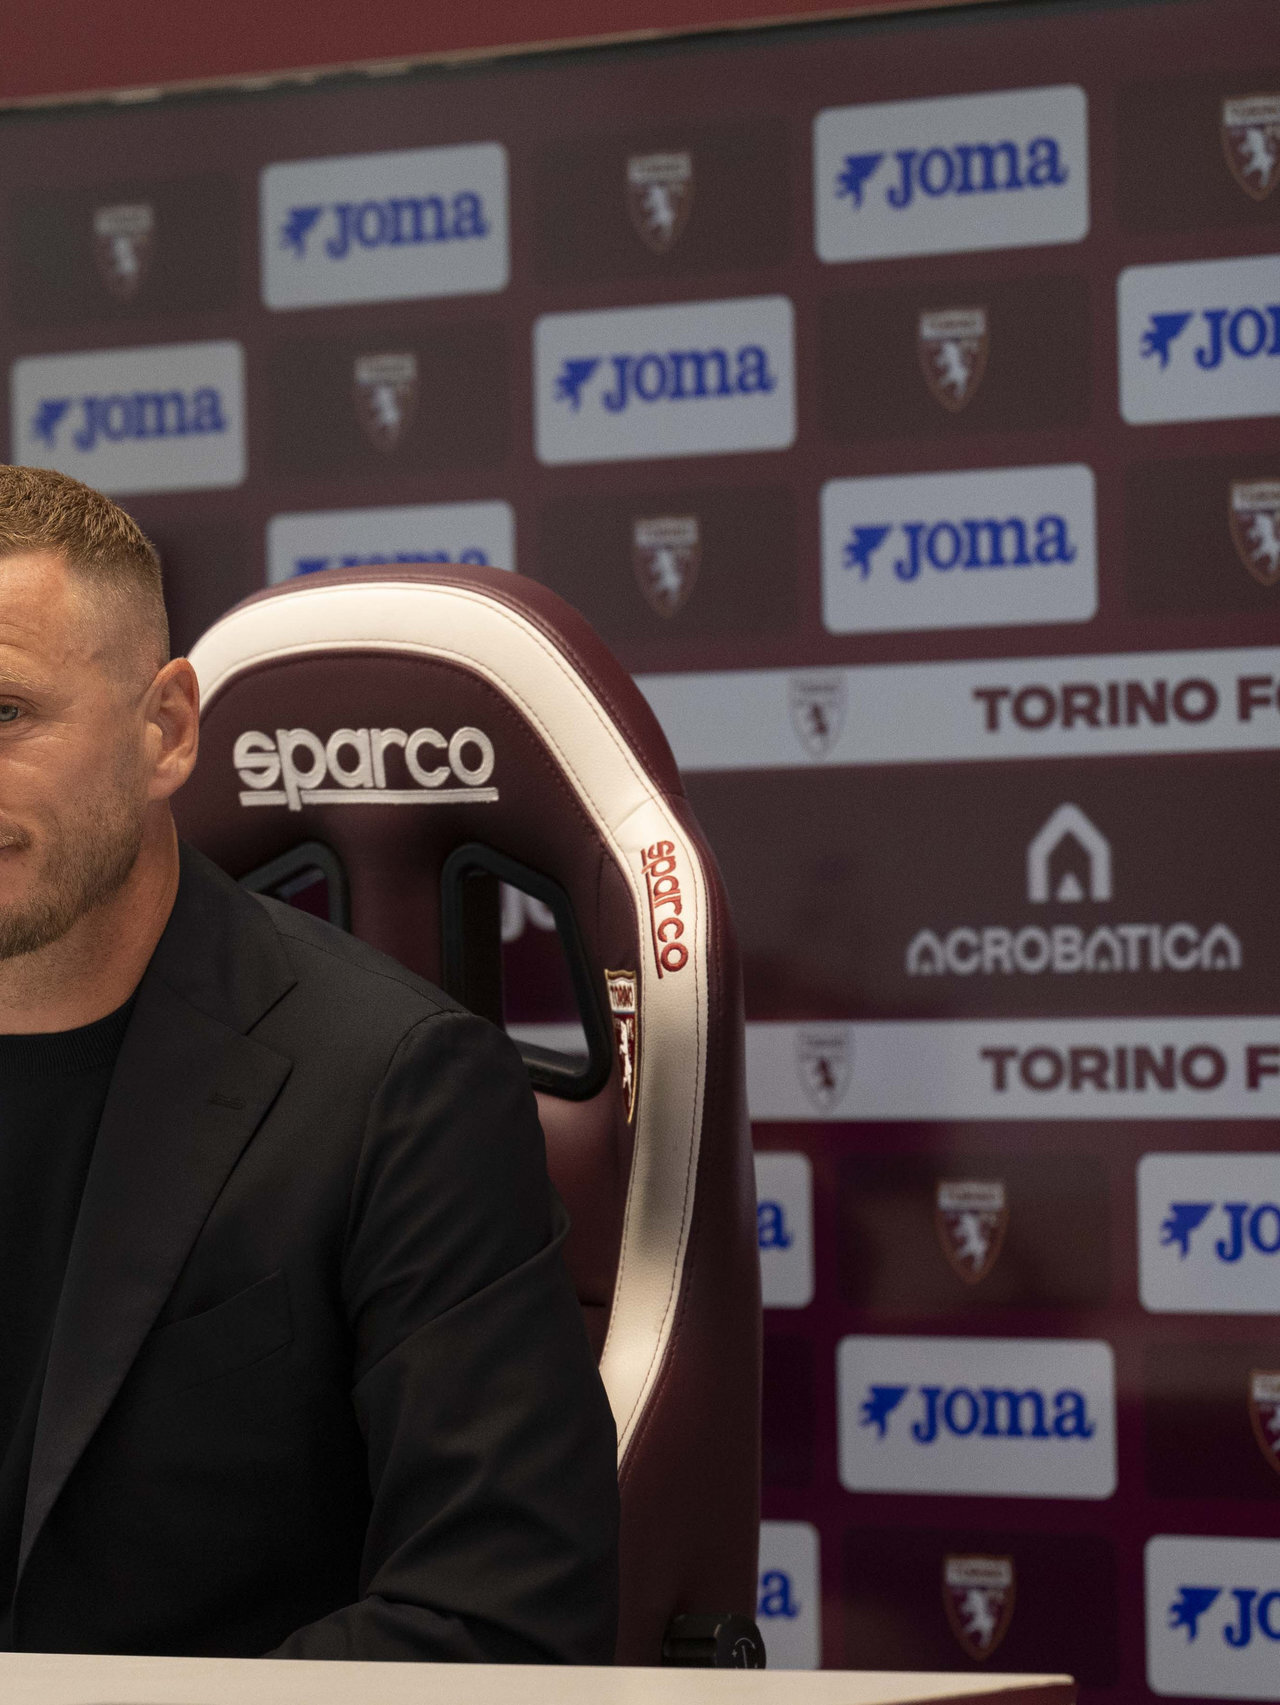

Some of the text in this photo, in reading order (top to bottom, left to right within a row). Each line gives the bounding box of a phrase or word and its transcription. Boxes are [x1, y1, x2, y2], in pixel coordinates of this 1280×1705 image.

[972, 674, 1280, 734] TORINO F
[233, 726, 496, 811] sparco
[640, 839, 689, 977] sparco
[906, 922, 1242, 975] ACROBATICA
[980, 1043, 1229, 1094] TORINO
